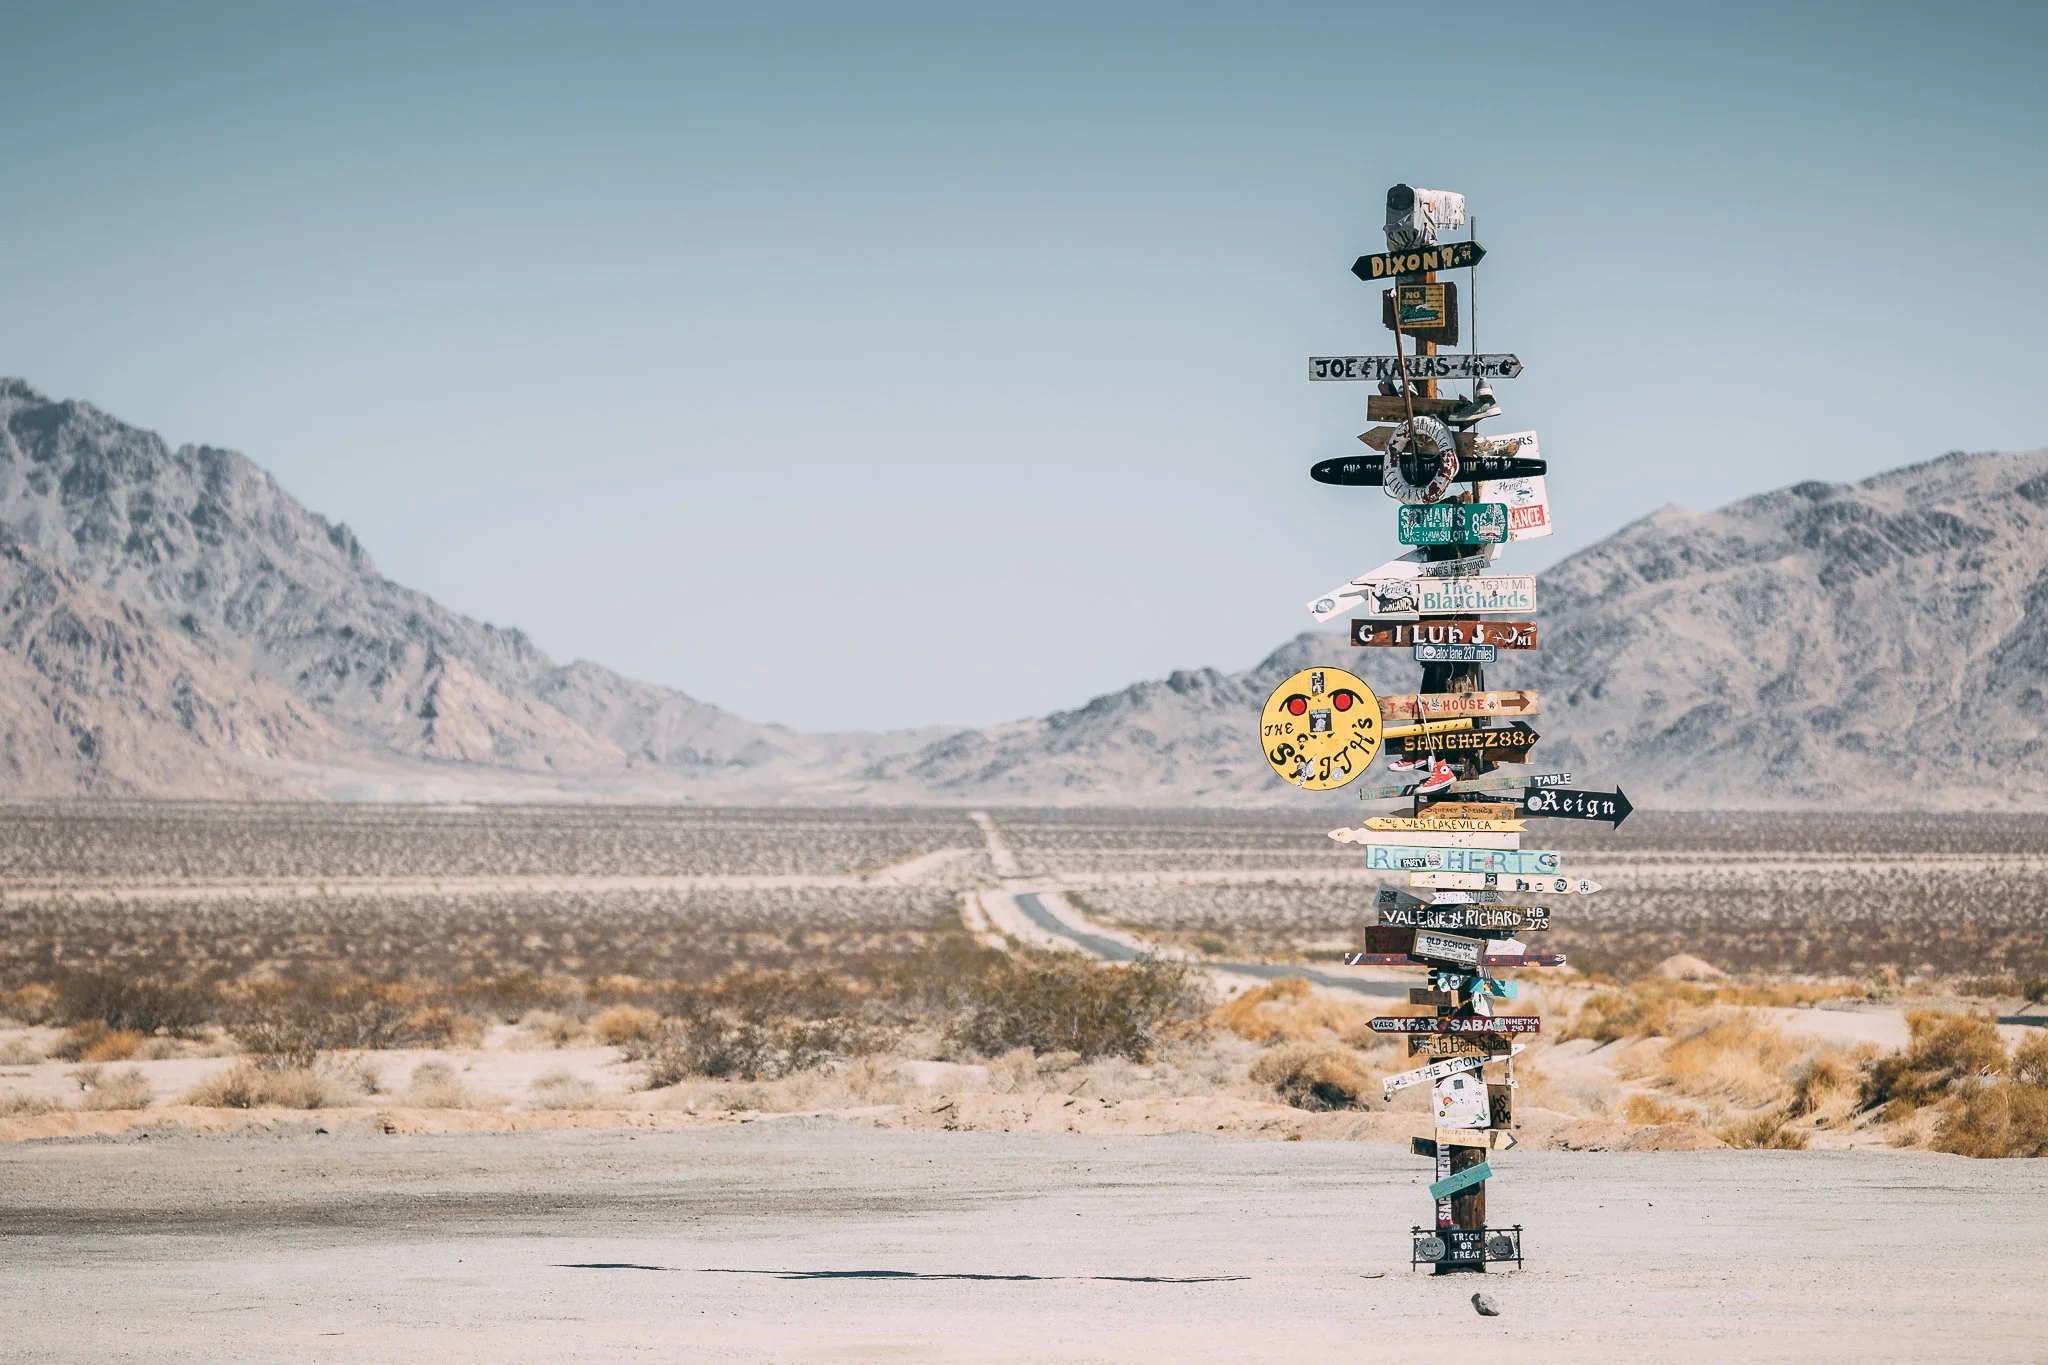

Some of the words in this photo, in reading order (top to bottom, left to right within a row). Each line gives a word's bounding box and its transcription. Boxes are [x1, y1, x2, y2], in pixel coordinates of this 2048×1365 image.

[1315, 358, 1357, 378] JOE
[1442, 582, 1473, 594] The
[1423, 591, 1529, 610] Blanchards
[1443, 699, 1485, 711] HOUSE
[1264, 722, 1294, 736] THE
[1404, 732, 1498, 752] SANCHEZ
[1535, 774, 1571, 787] TABLE
[1540, 790, 1616, 818] Reign
[1402, 858, 1425, 868] PARTY
[1383, 910, 1446, 926] VALERIE
[1465, 909, 1521, 927] RICHARD
[1526, 908, 1544, 917] HB
[1426, 936, 1442, 946] OLD
[1449, 1034, 1477, 1054] Bean
[1415, 1065, 1441, 1081] THE
[1452, 1233, 1480, 1241] TRICK
[1460, 1241, 1472, 1250] OR
[1453, 1250, 1481, 1259] TREAT
